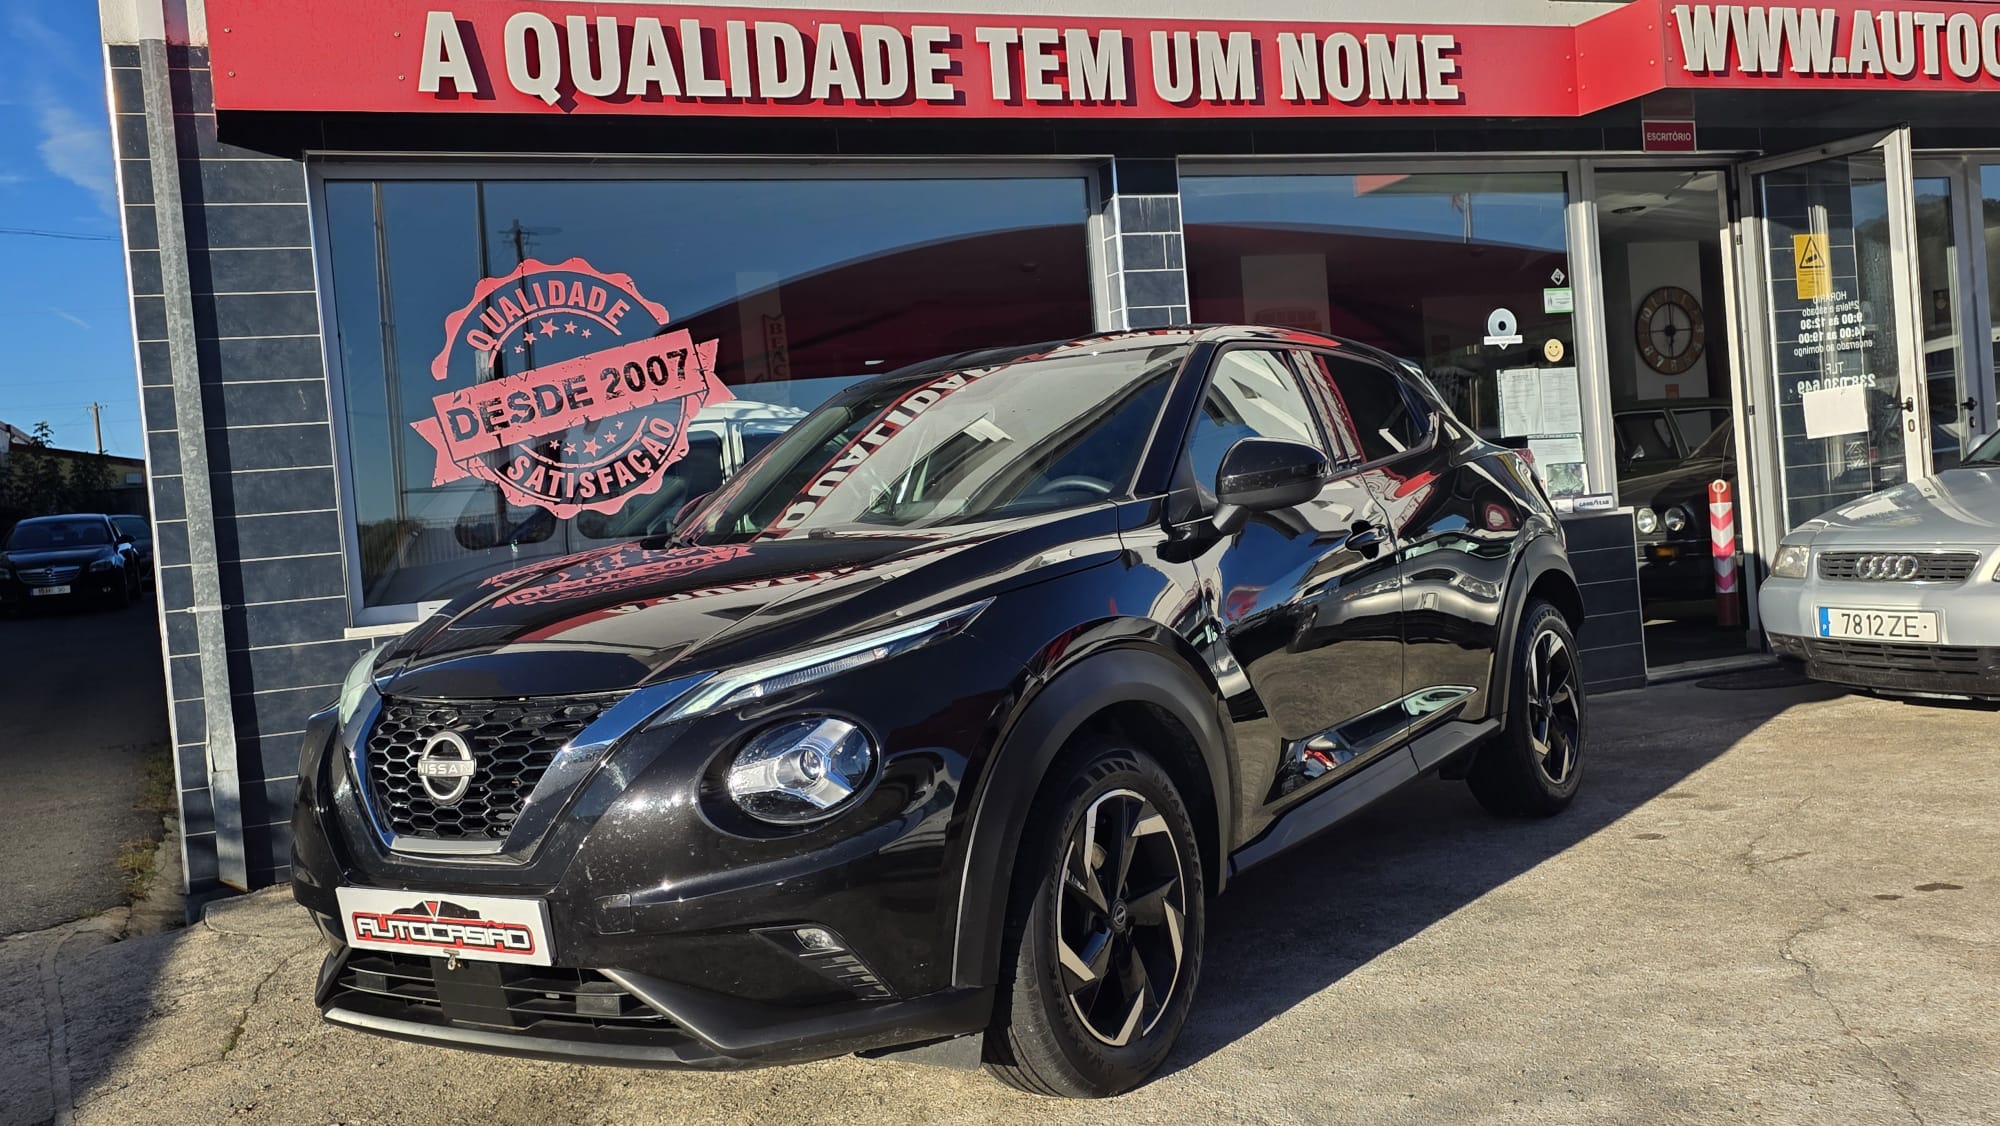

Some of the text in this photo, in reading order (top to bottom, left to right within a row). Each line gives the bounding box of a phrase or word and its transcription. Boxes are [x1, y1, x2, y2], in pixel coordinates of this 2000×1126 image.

[417, 11, 1460, 106] A QUALIDADE TEM UM NOME
[1646, 130, 1692, 142] ESCRITÓRIO
[466, 280, 631, 351] QUALIDADE
[446, 347, 689, 443] DESDE 2007
